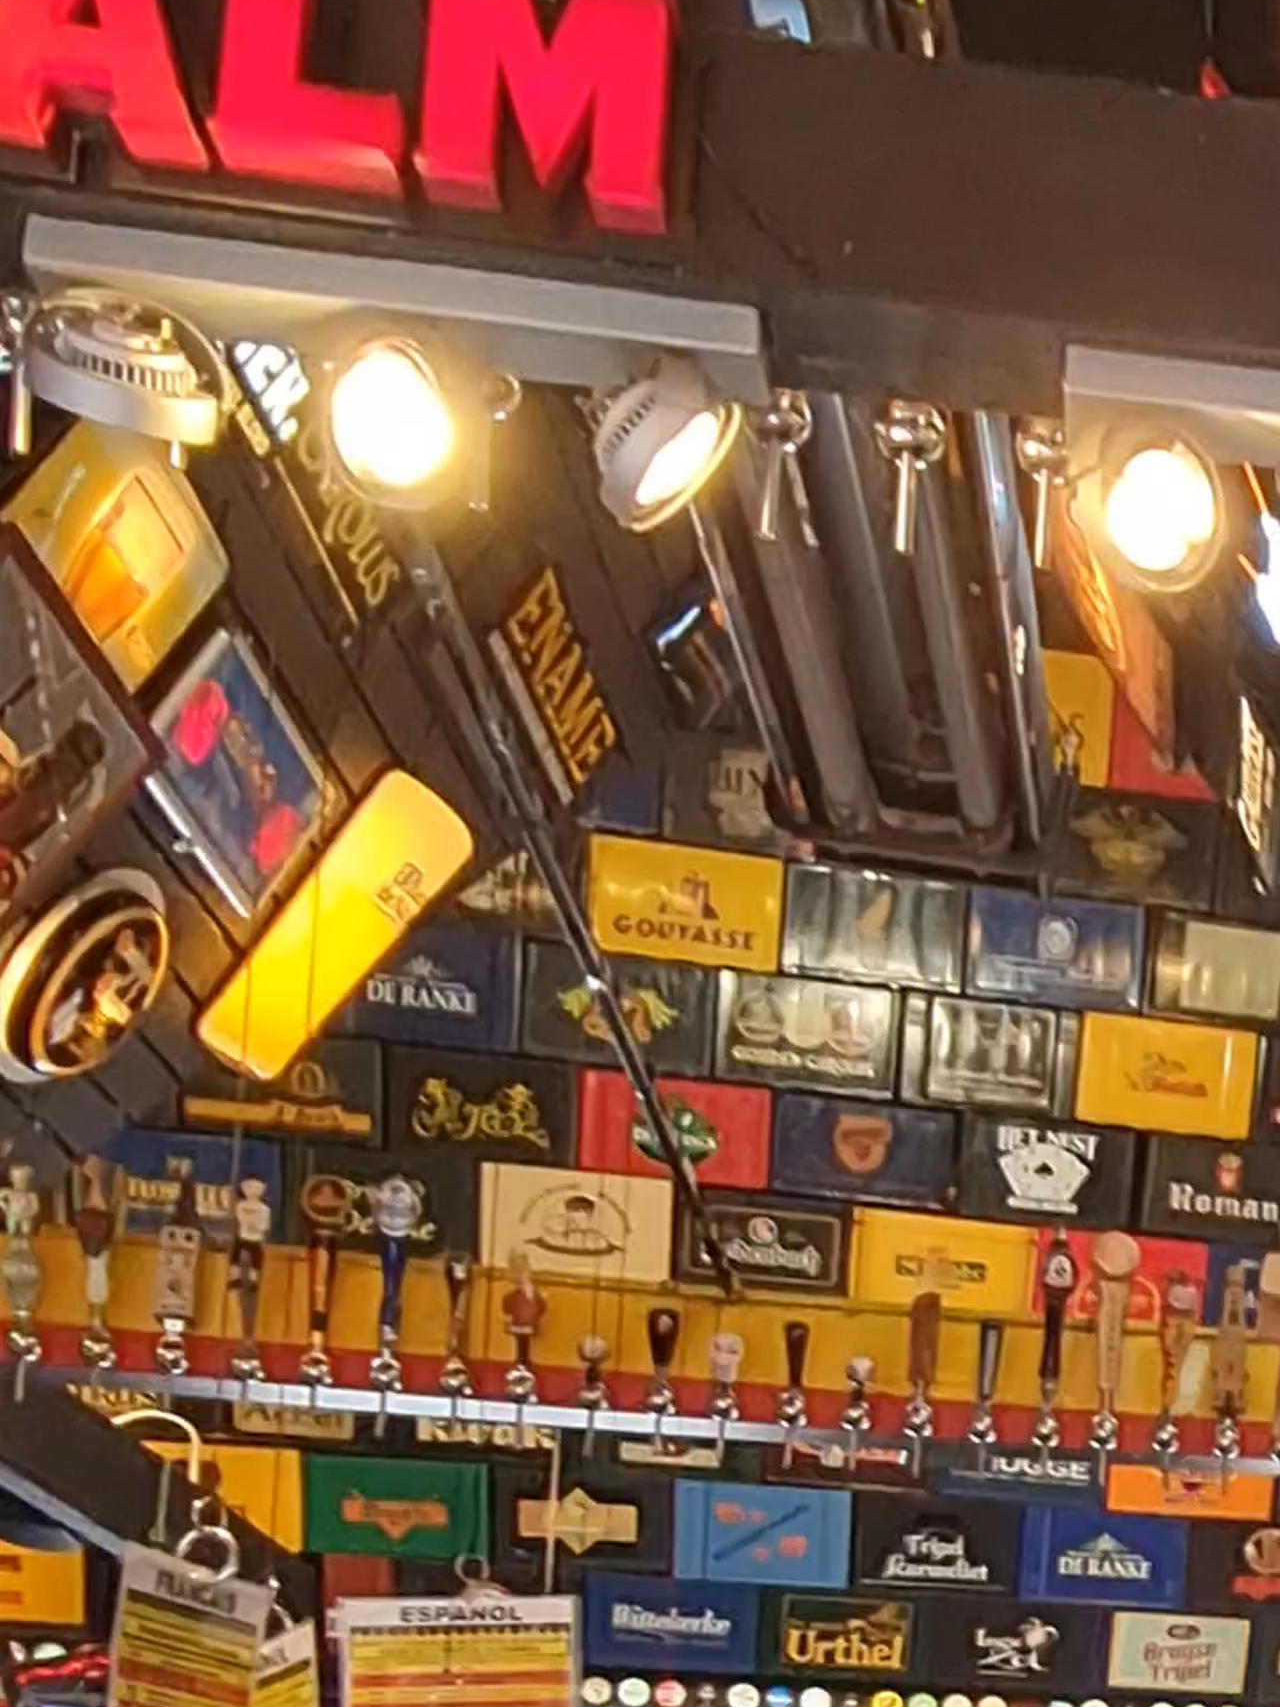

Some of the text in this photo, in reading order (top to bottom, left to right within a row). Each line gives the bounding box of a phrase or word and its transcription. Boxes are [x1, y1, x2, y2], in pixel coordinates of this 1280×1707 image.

[611, 913, 757, 953] GOUYASSE
[1167, 1180, 1280, 1224] Roman
[784, 1624, 907, 1671] Urthel
